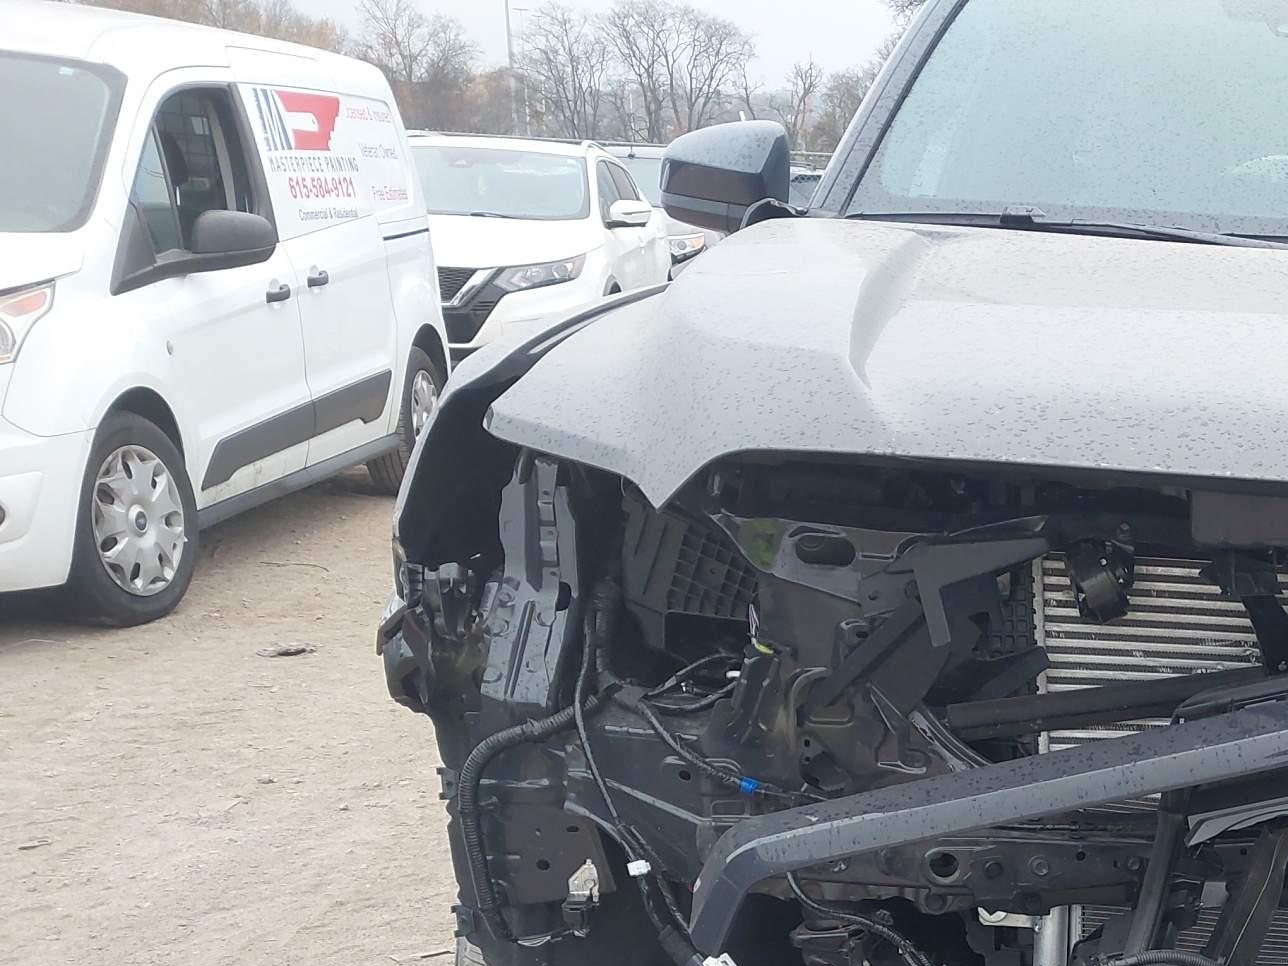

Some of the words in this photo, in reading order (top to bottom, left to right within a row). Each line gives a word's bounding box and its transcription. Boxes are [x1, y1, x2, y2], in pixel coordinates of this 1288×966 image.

[267, 155, 324, 173] MASTERPIECE
[326, 156, 360, 173] PAINTING
[288, 176, 357, 199] 615-584-9121
[299, 208, 328, 221] Commercial
